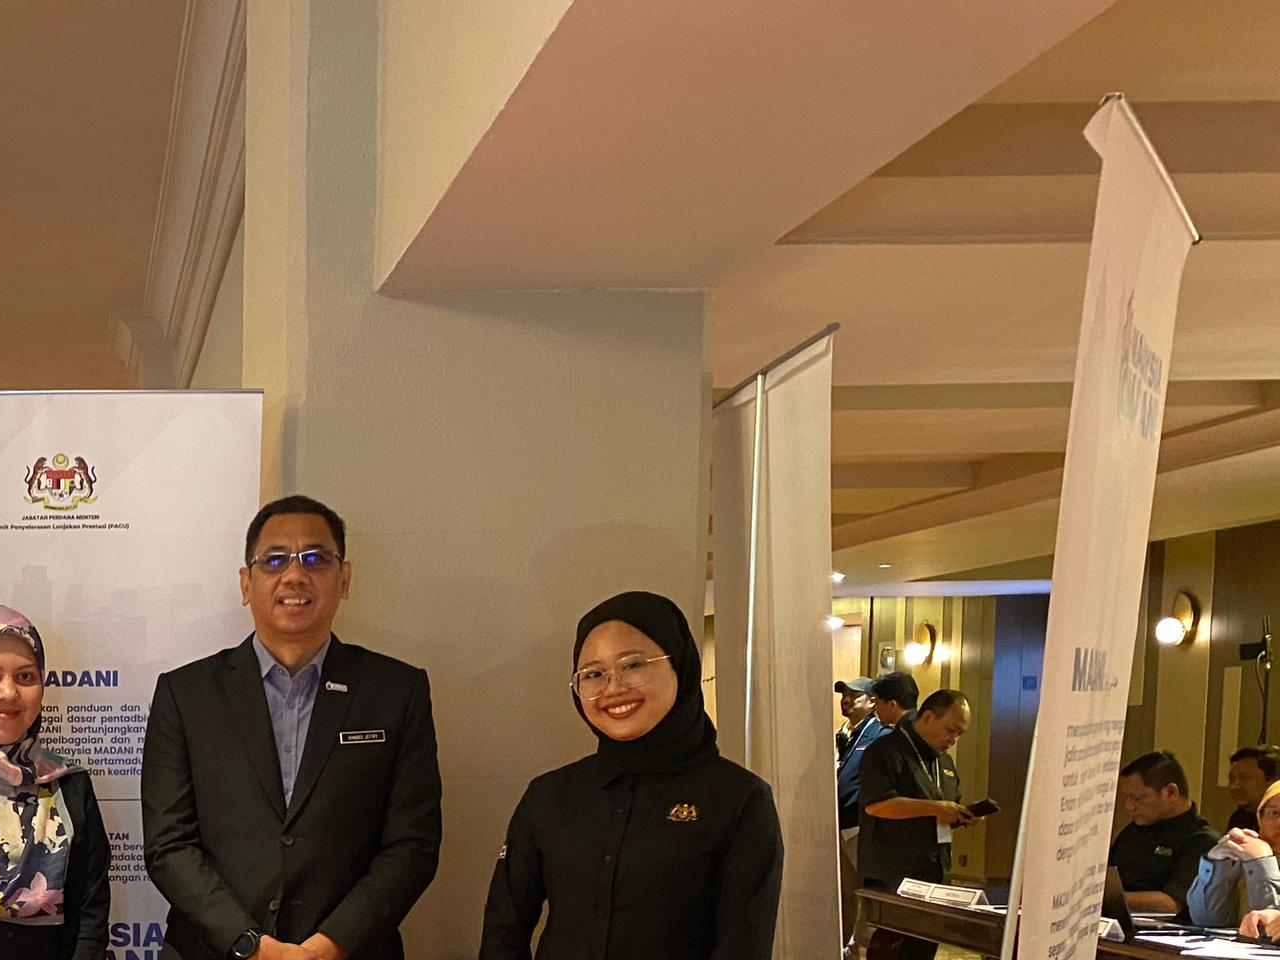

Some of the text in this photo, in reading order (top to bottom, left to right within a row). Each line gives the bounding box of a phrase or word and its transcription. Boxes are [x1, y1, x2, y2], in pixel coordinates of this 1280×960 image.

[67, 704, 140, 714] panduan dan
[71, 725, 146, 736] bertunjangkan
[110, 736, 130, 744] dan
